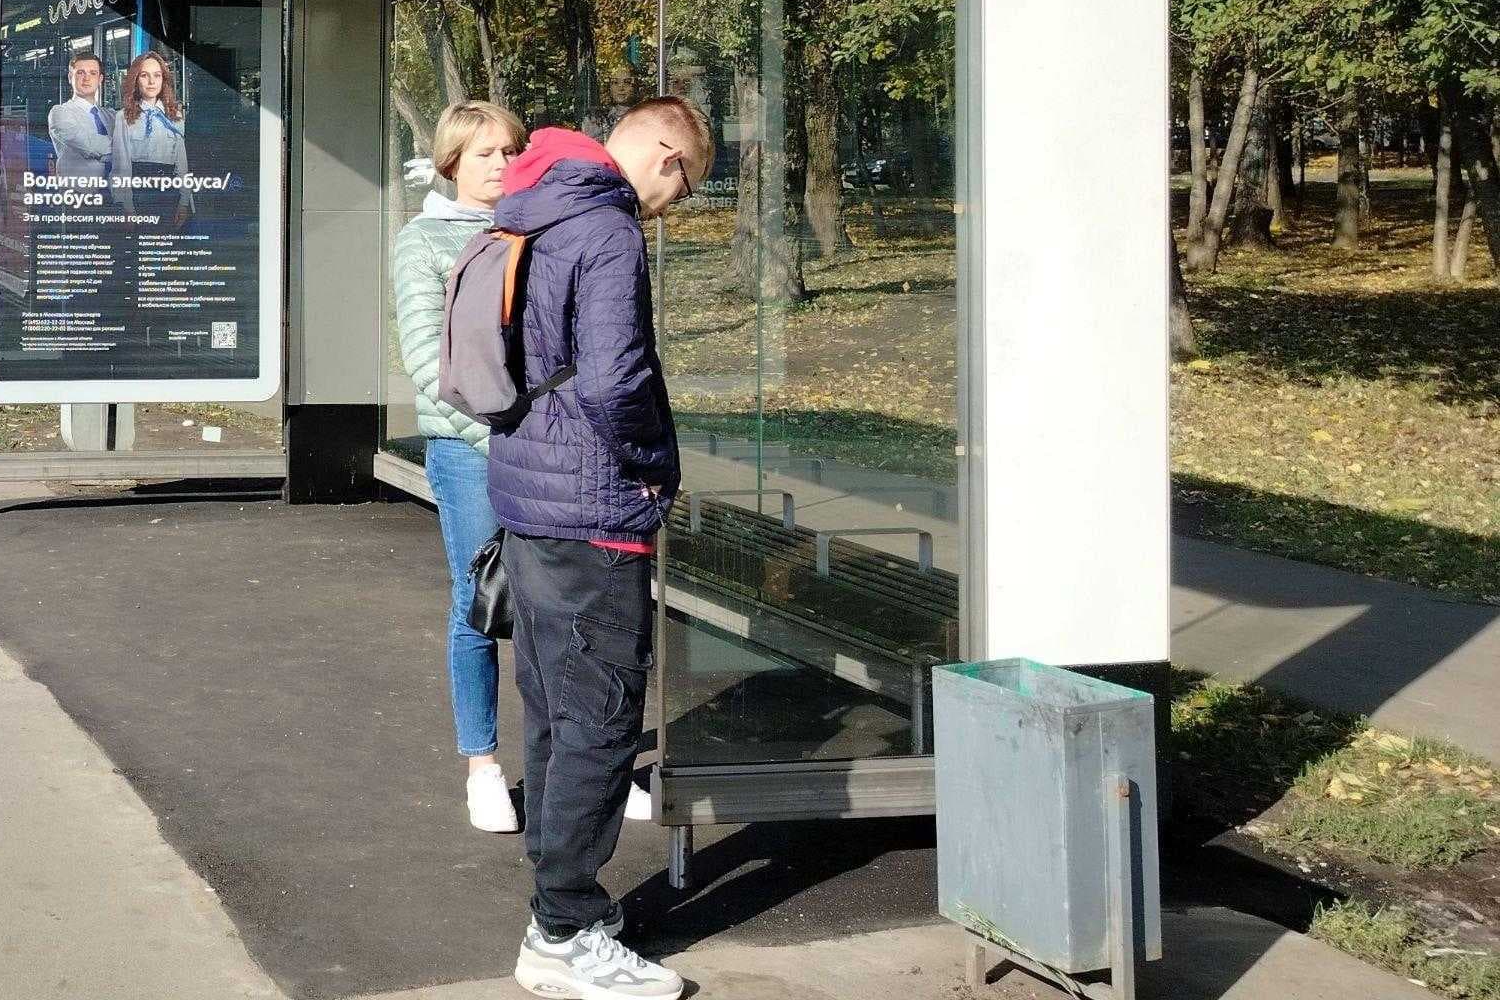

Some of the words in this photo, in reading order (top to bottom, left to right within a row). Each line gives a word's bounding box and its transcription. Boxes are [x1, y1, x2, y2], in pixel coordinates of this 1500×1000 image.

[23, 172, 108, 190] Водитель
[112, 172, 231, 192] электробуса/
[23, 190, 104, 209] автобуса
[23, 213, 40, 223] Эта
[41, 212, 94, 225] профессия
[96, 214, 125, 224] нужна
[127, 214, 160, 226] городу
